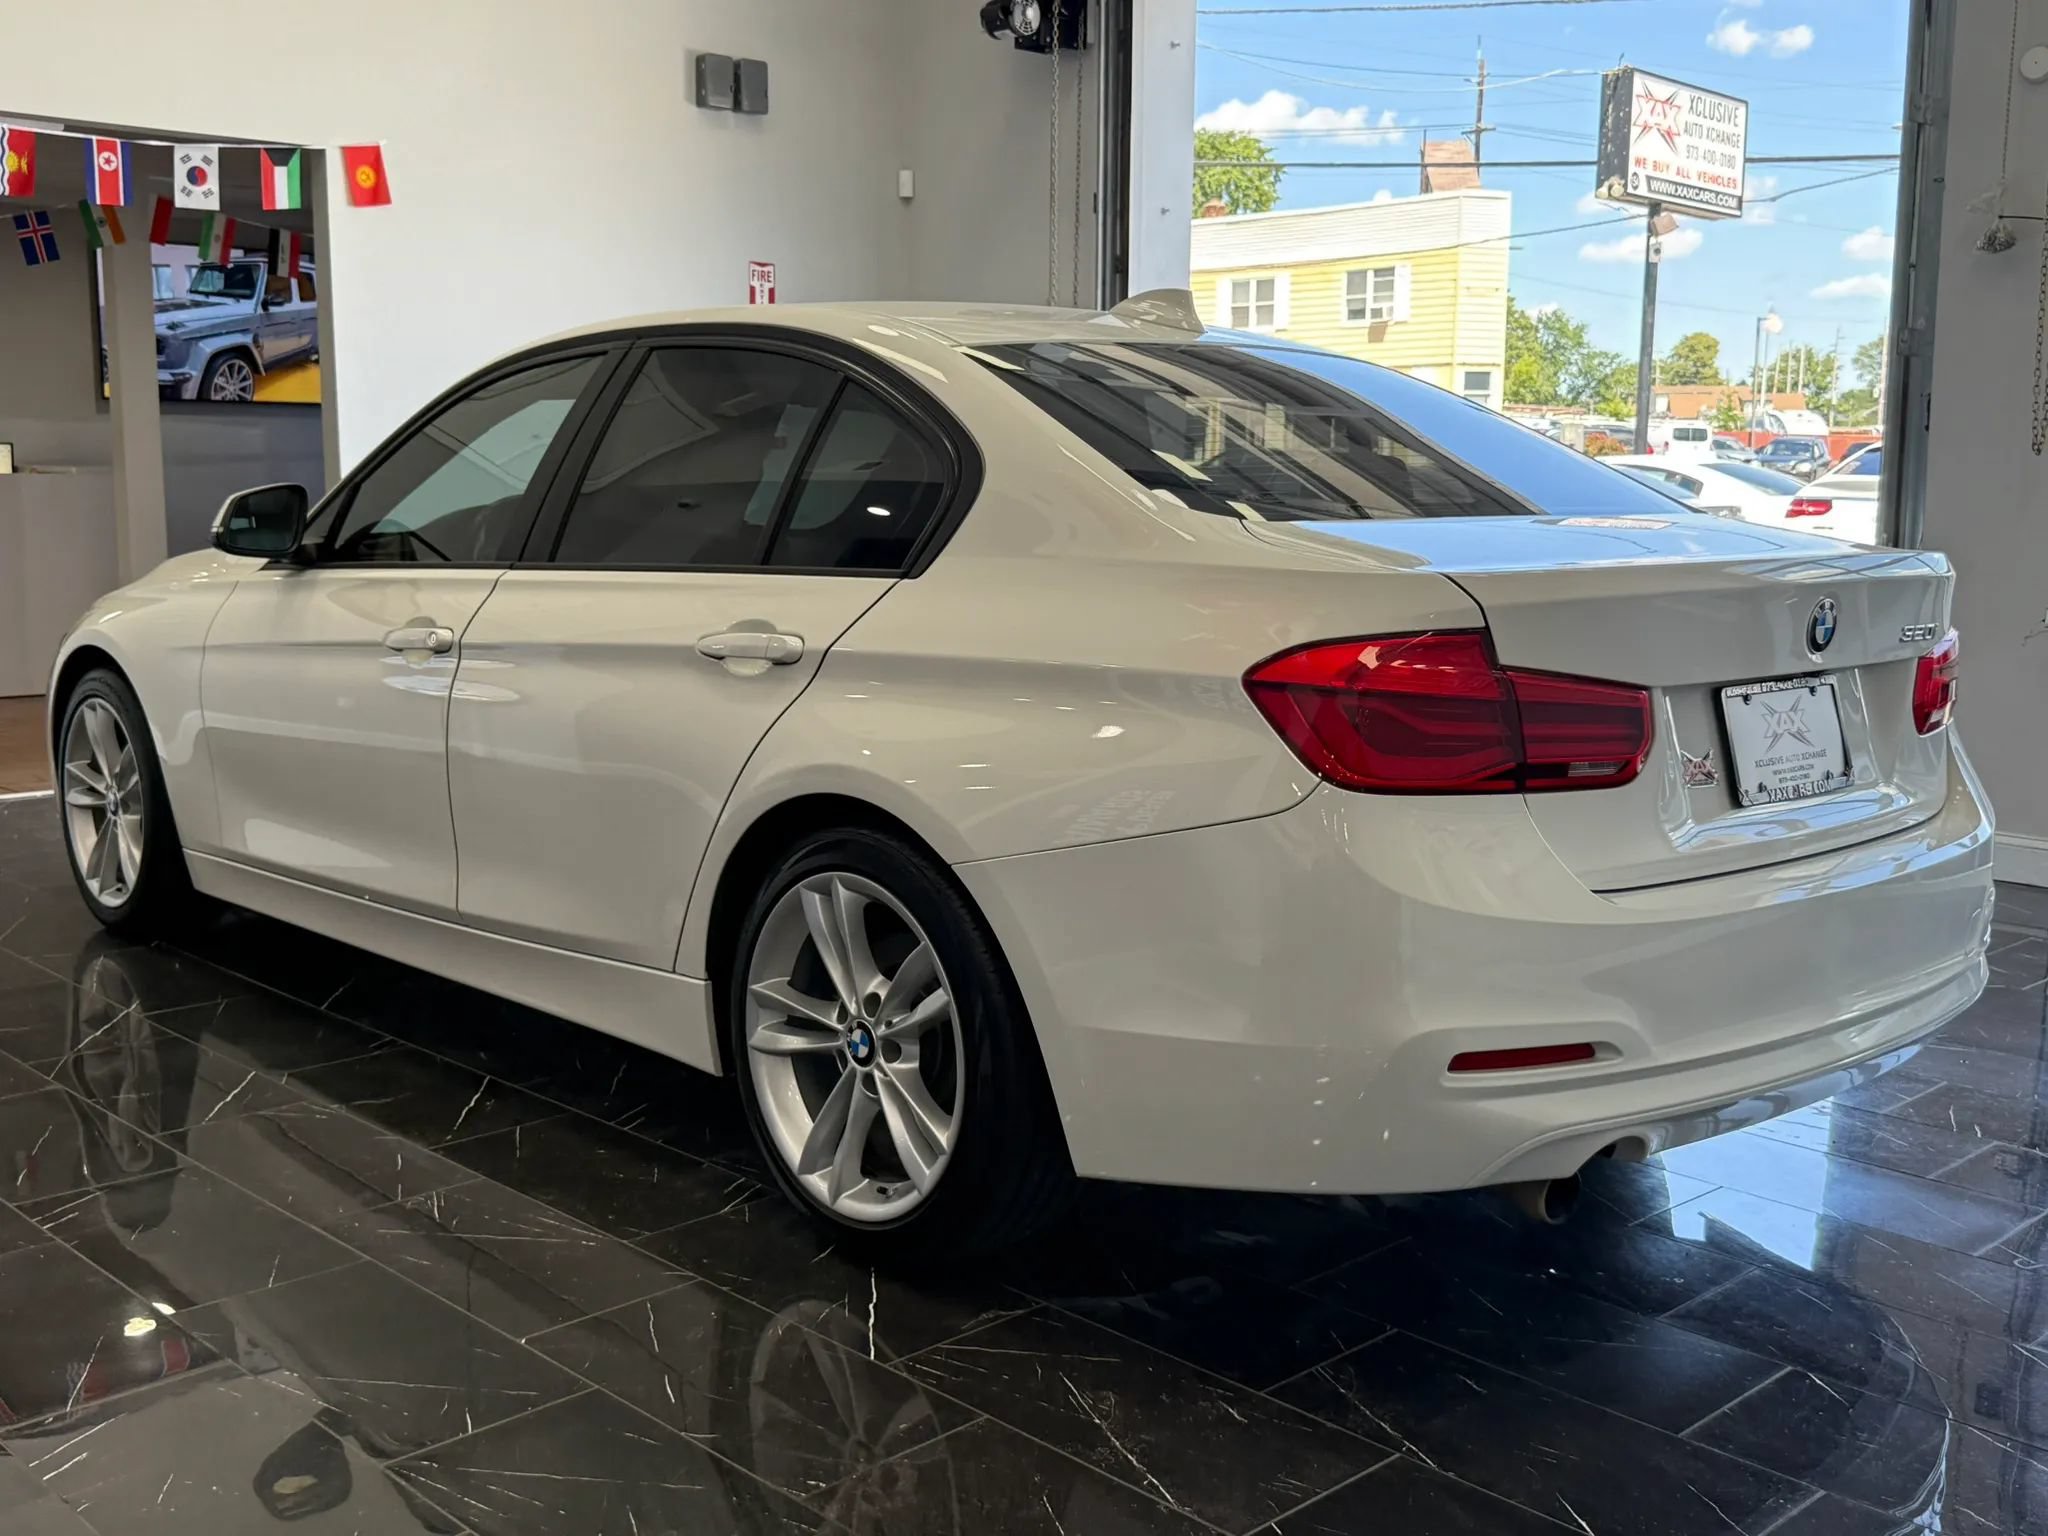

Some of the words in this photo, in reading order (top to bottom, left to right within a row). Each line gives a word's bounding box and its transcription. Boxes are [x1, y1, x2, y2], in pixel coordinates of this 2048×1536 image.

[1688, 94, 1739, 127] XCLUSIVE
[1684, 120, 1703, 139] AUTO
[1706, 126, 1741, 149] XCHANGE
[1634, 155, 1647, 169] WE
[1652, 160, 1671, 174] BUY
[1676, 166, 1691, 180] ALL
[1697, 170, 1737, 190] VEHICLES
[1650, 178, 1738, 208] WWW.XAXCARS.COM
[751, 269, 773, 283] FIRE
[1761, 706, 1811, 740] XAX
[1754, 755, 1785, 768] XCLUSIVE
[1801, 748, 1828, 761] XCHANGE
